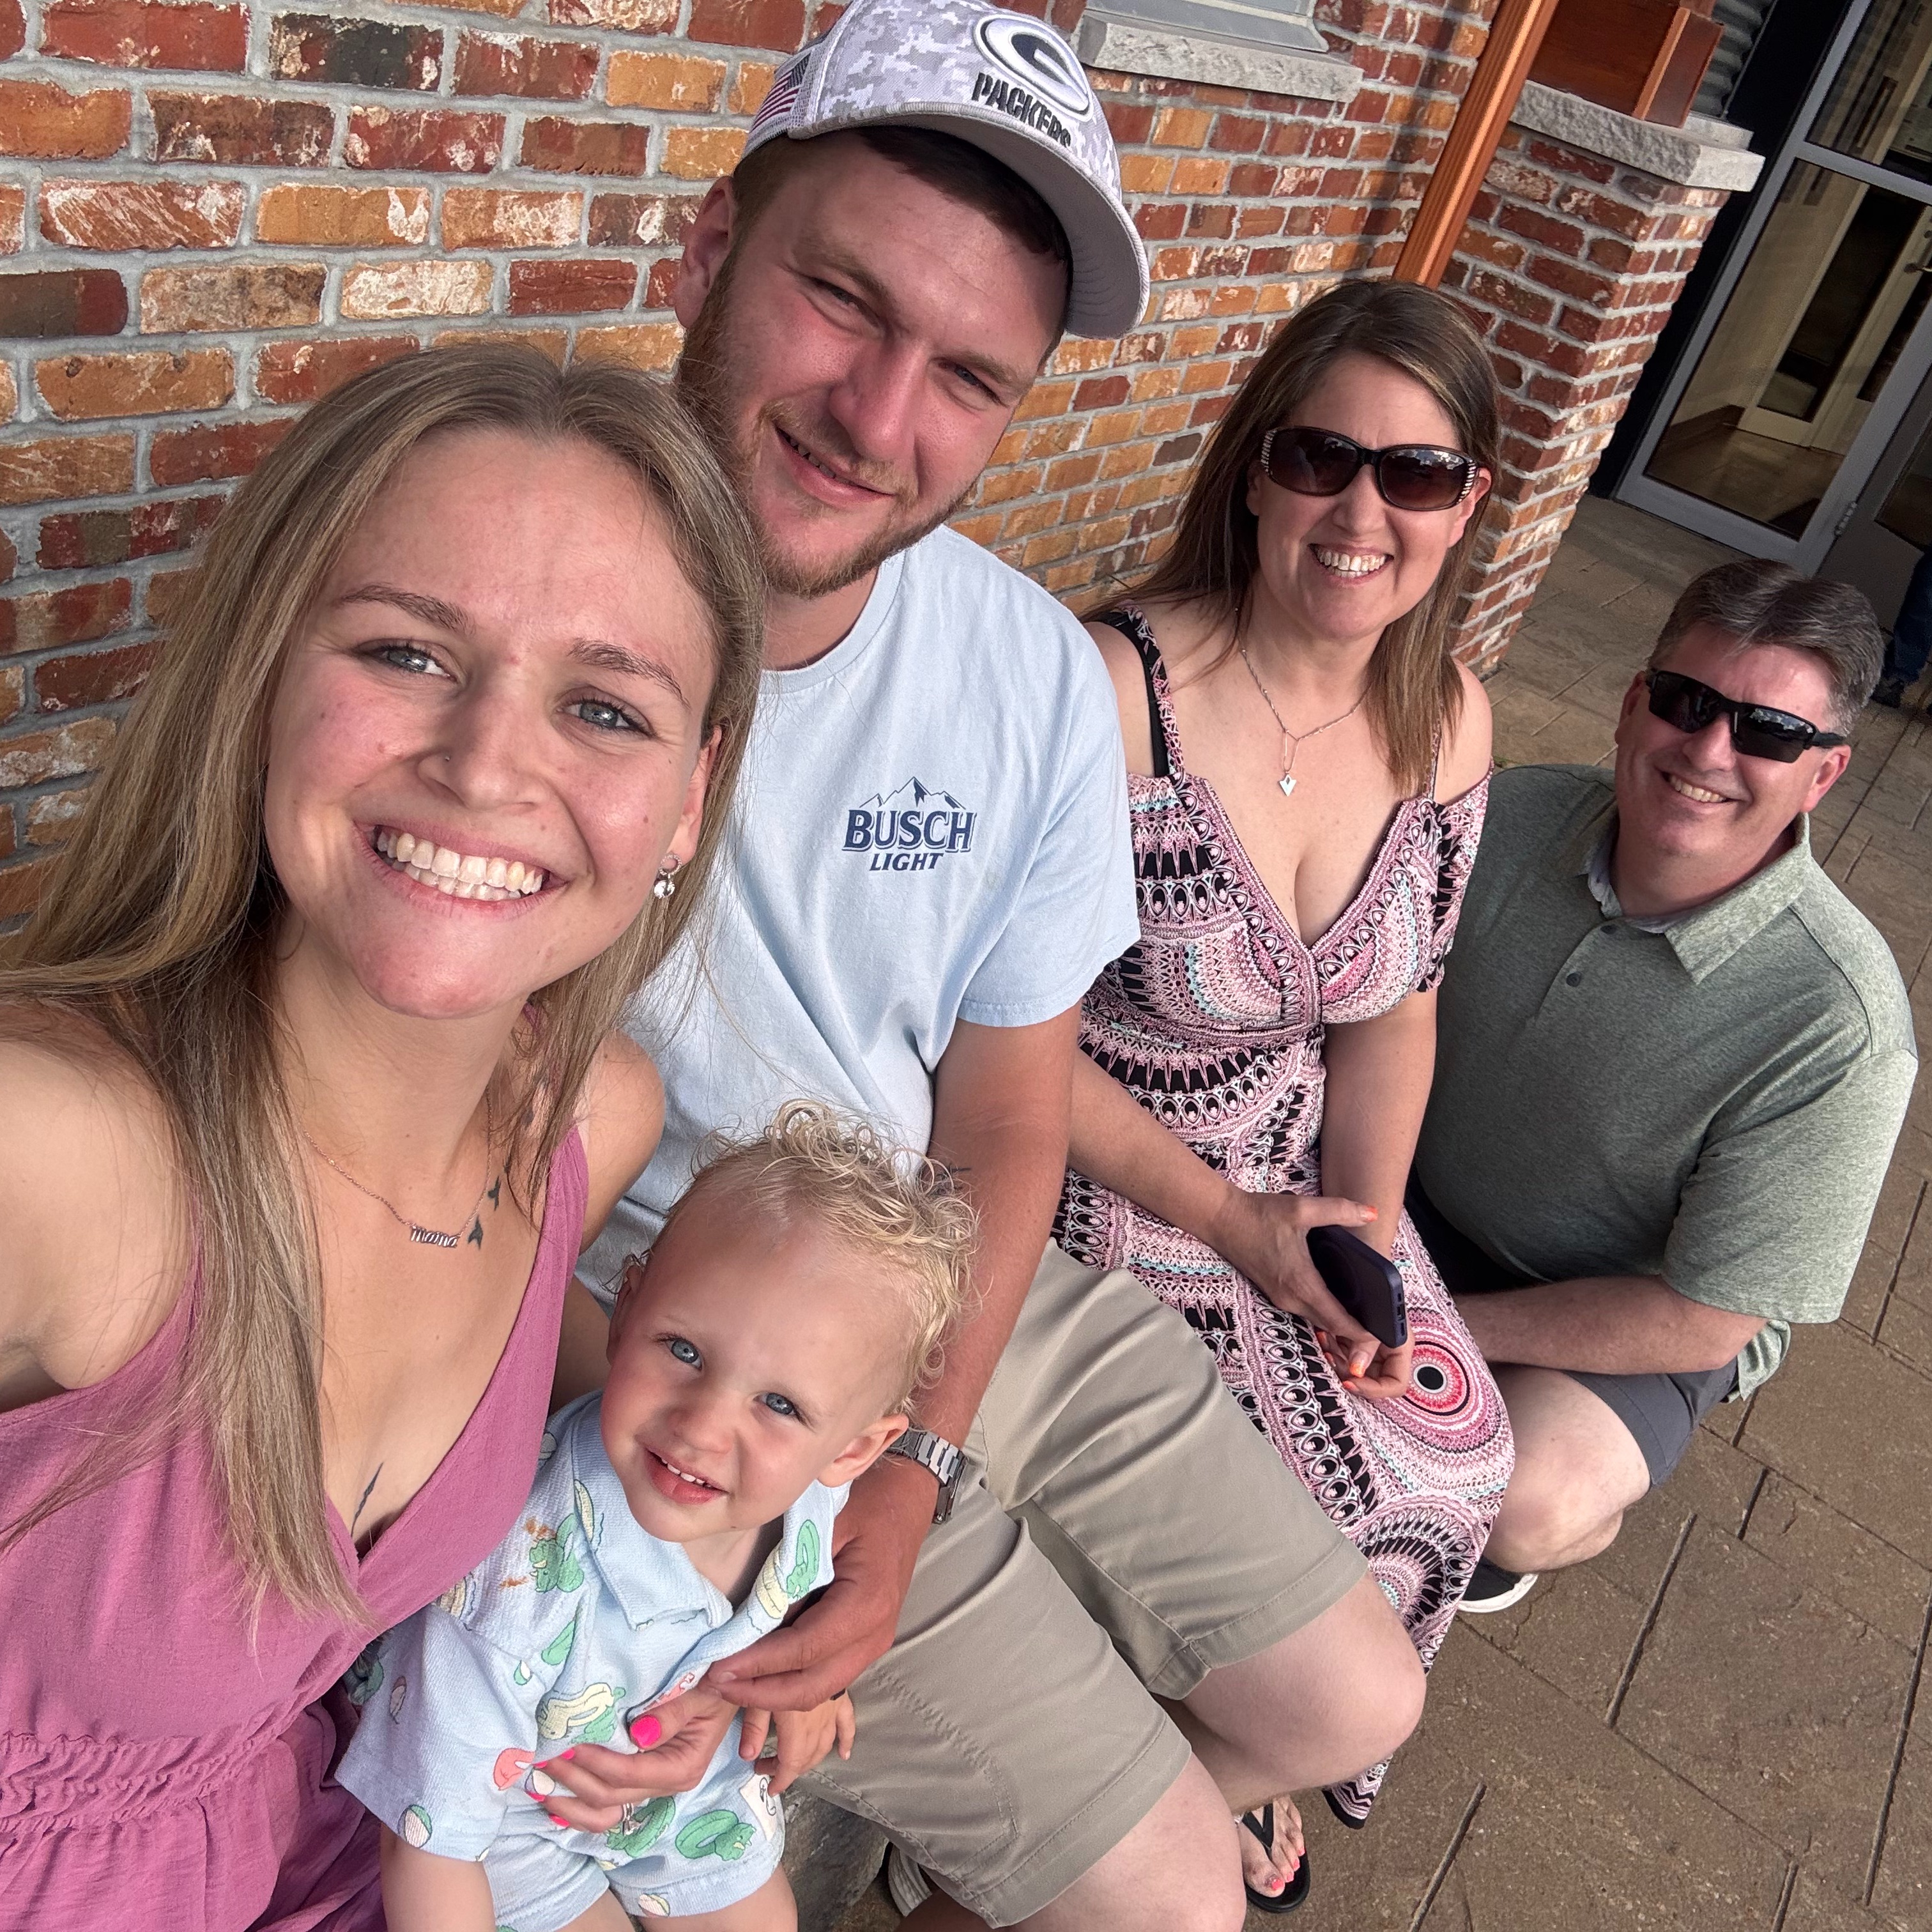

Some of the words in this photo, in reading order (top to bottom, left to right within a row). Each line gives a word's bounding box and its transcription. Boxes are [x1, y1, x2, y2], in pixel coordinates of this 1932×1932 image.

[979, 16, 1090, 116] G
[971, 72, 1071, 148] PACKERS
[842, 809, 977, 853] BUSCH
[869, 852, 944, 871] LIGHT
